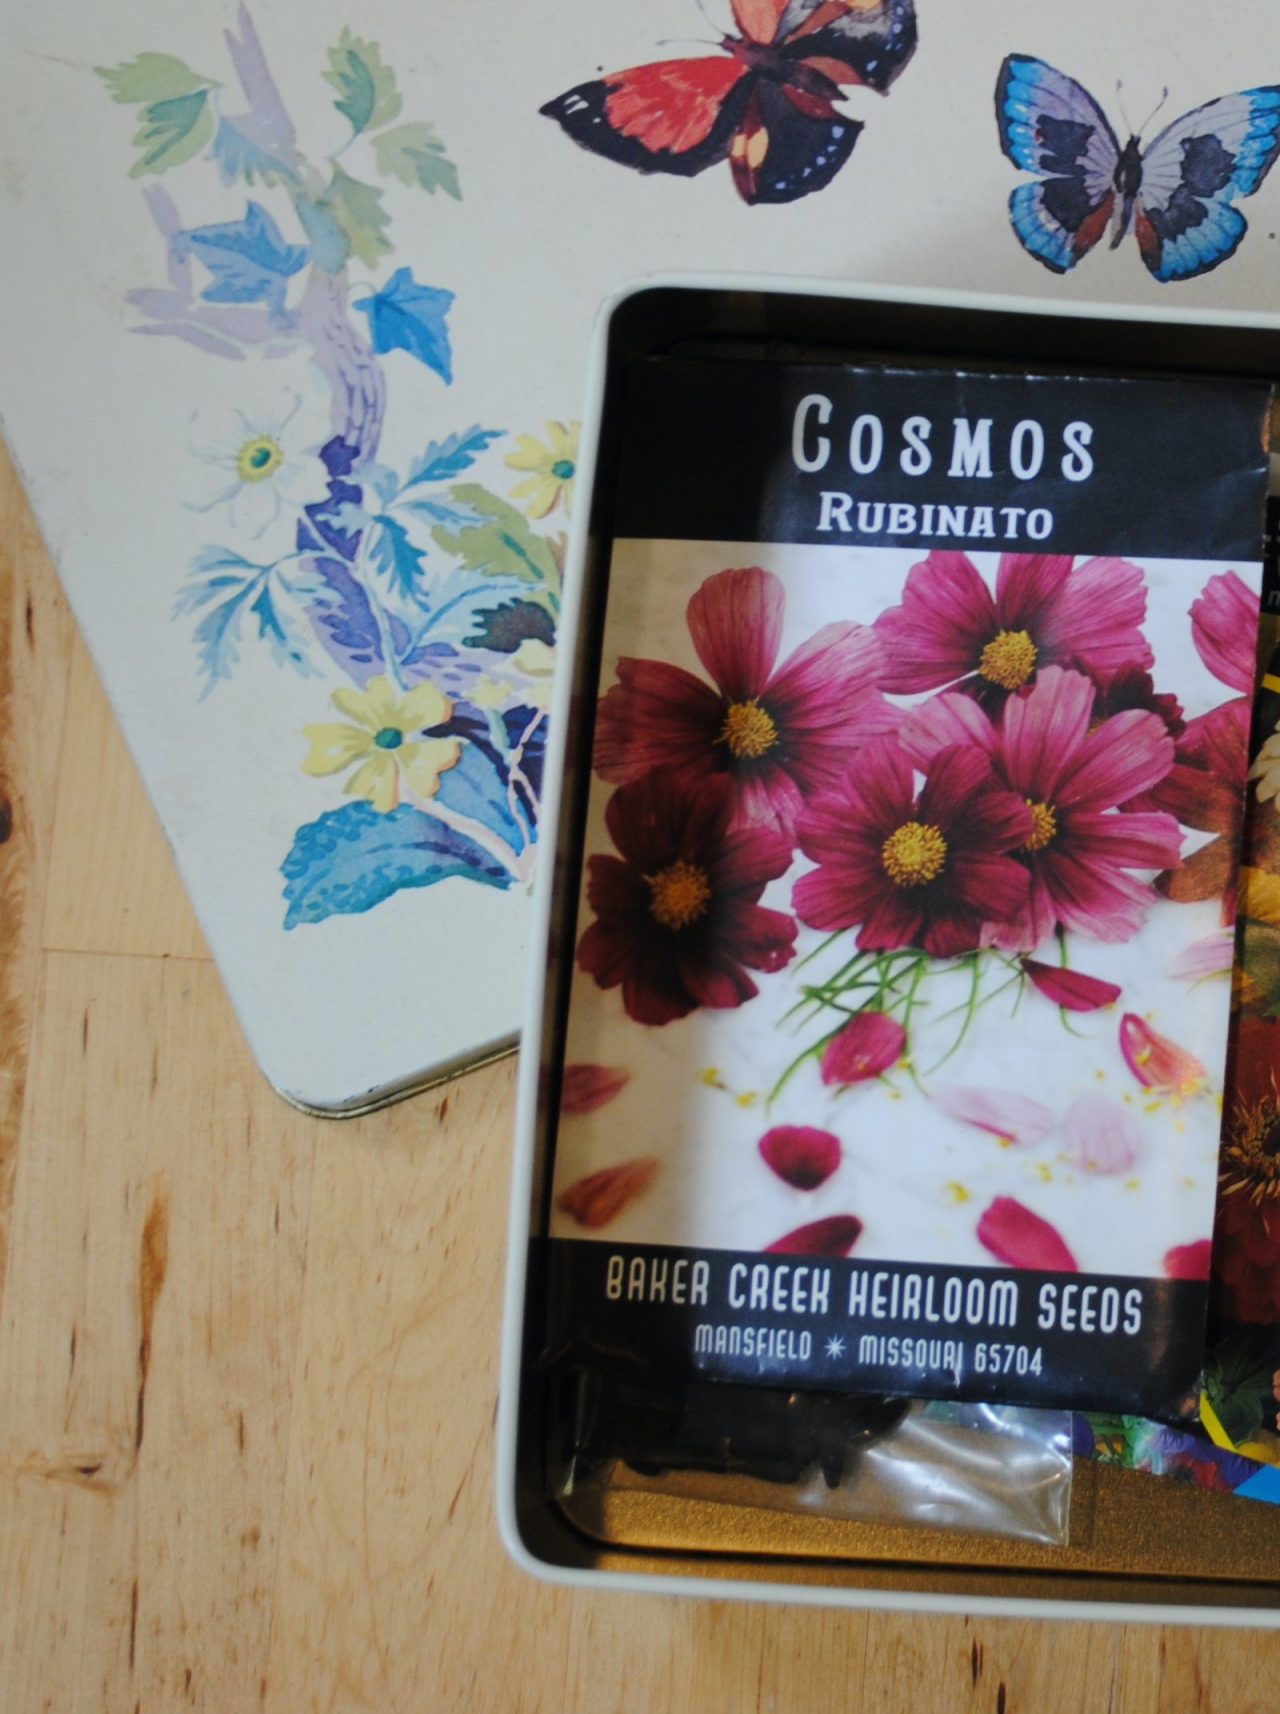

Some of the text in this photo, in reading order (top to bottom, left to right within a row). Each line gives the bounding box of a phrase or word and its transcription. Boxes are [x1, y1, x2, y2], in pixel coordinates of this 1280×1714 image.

[607, 1256, 1142, 1334] BAKER CREEK HEIRLOOM SEEDS
[695, 1324, 1042, 1376] MANSFIELD MISSOURI 65704
